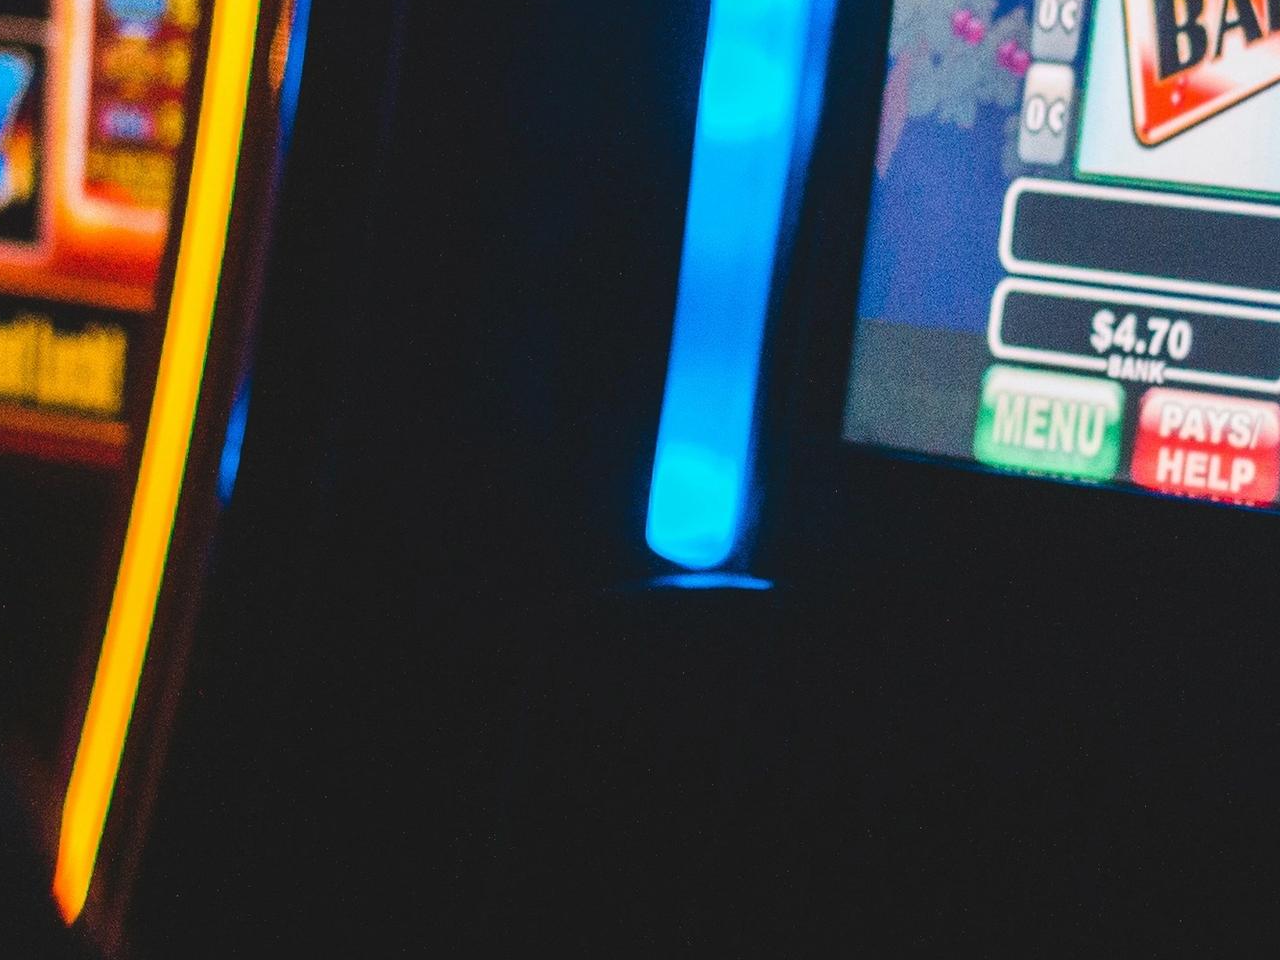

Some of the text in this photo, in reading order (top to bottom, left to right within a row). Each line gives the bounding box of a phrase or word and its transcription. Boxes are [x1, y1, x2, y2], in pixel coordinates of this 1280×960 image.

[1090, 309, 1193, 360] $4.70
[1106, 354, 1166, 384] BANK
[991, 393, 1108, 457] MENU
[1158, 403, 1266, 450] PAYS/
[1155, 447, 1258, 493] HELP
